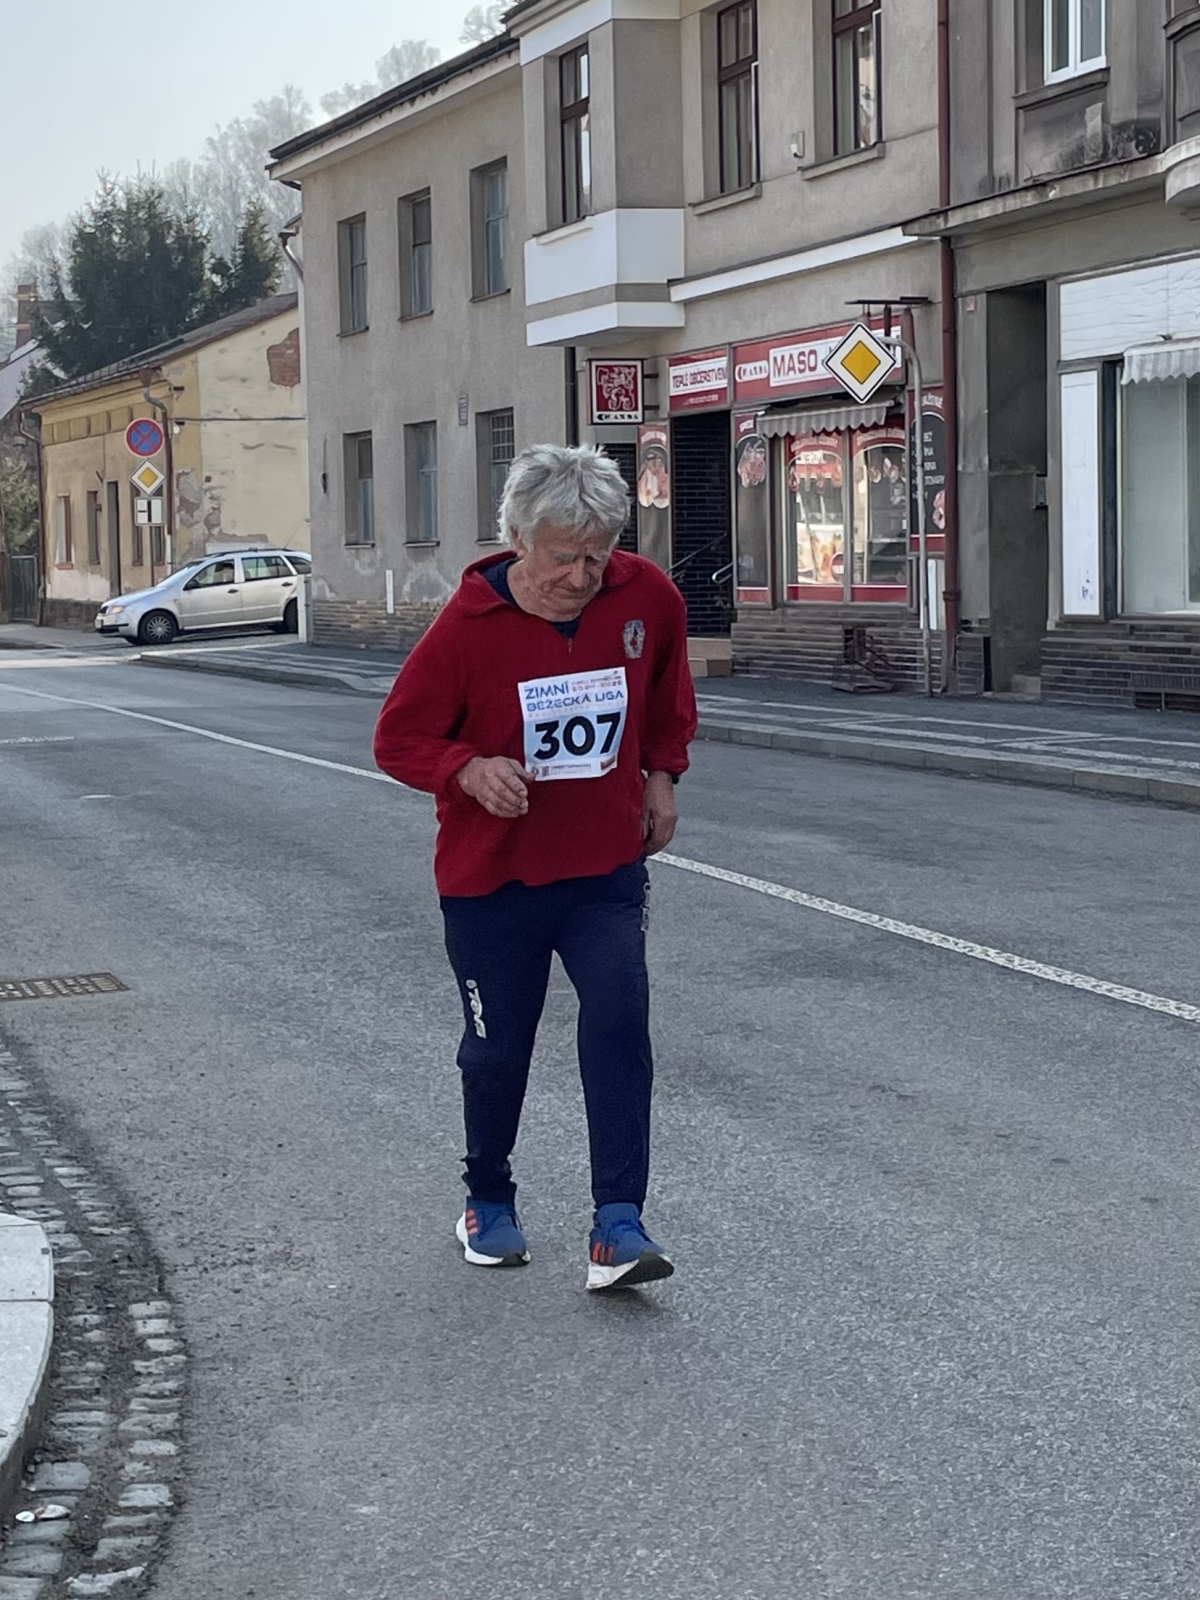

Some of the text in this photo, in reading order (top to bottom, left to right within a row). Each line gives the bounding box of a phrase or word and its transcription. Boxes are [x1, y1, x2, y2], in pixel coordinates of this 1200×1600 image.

[773, 349, 818, 378] MASO
[595, 690, 624, 702] LIGA
[533, 712, 621, 760] 307
